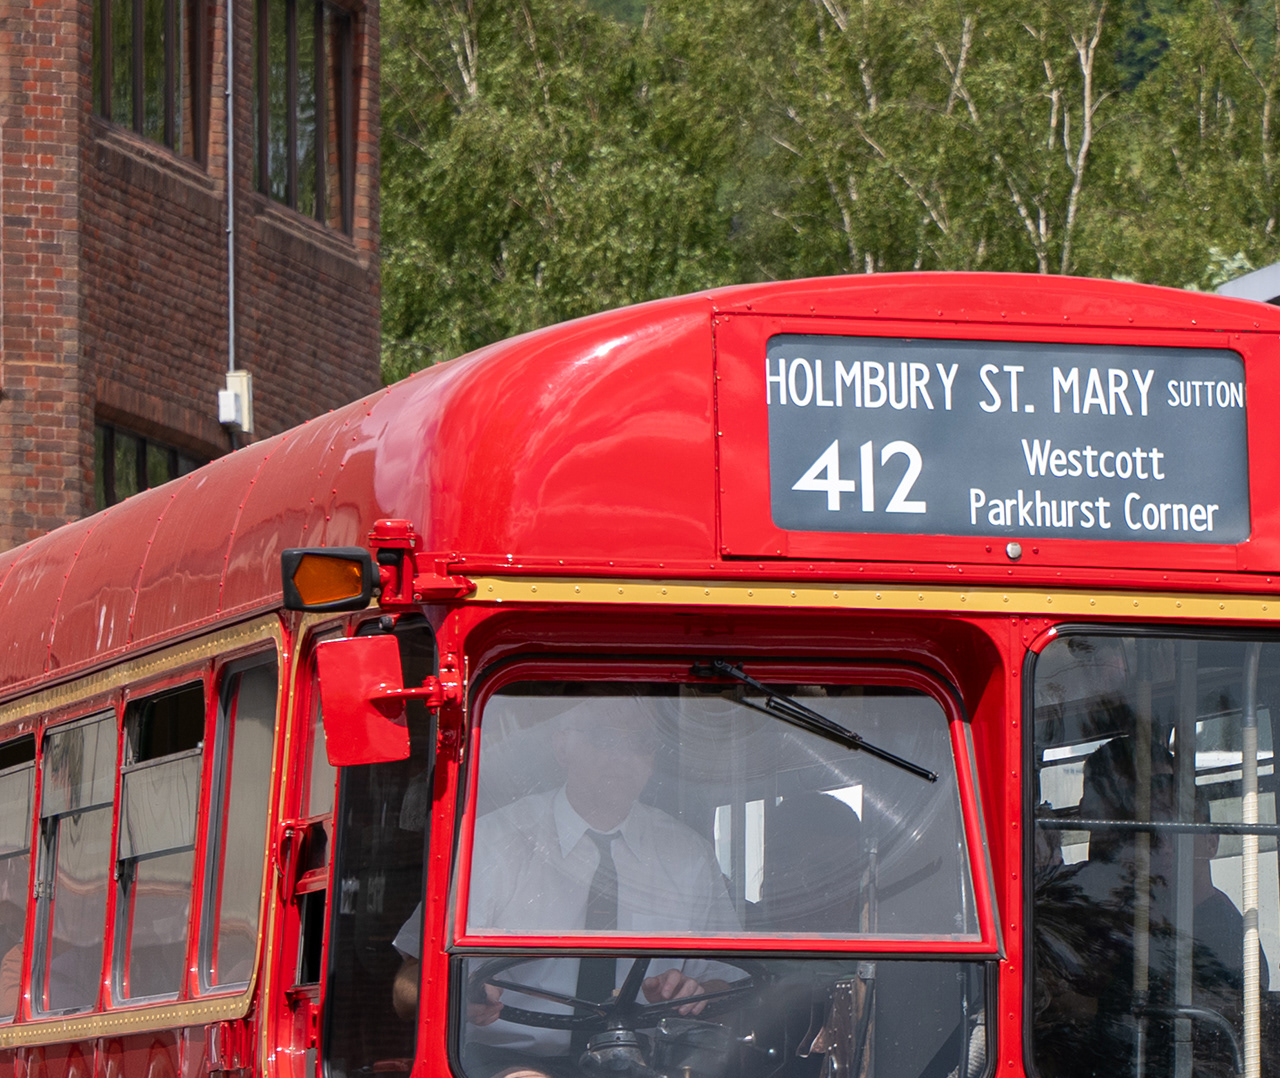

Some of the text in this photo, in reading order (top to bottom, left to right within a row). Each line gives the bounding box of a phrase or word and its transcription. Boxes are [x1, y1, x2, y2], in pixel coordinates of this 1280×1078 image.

[766, 357, 1244, 417] HOLMBURY ST. MARY SUTTON
[791, 438, 927, 514] 412
[1021, 438, 1166, 481] Westcott
[969, 487, 1219, 532] Parkhurst Corner
